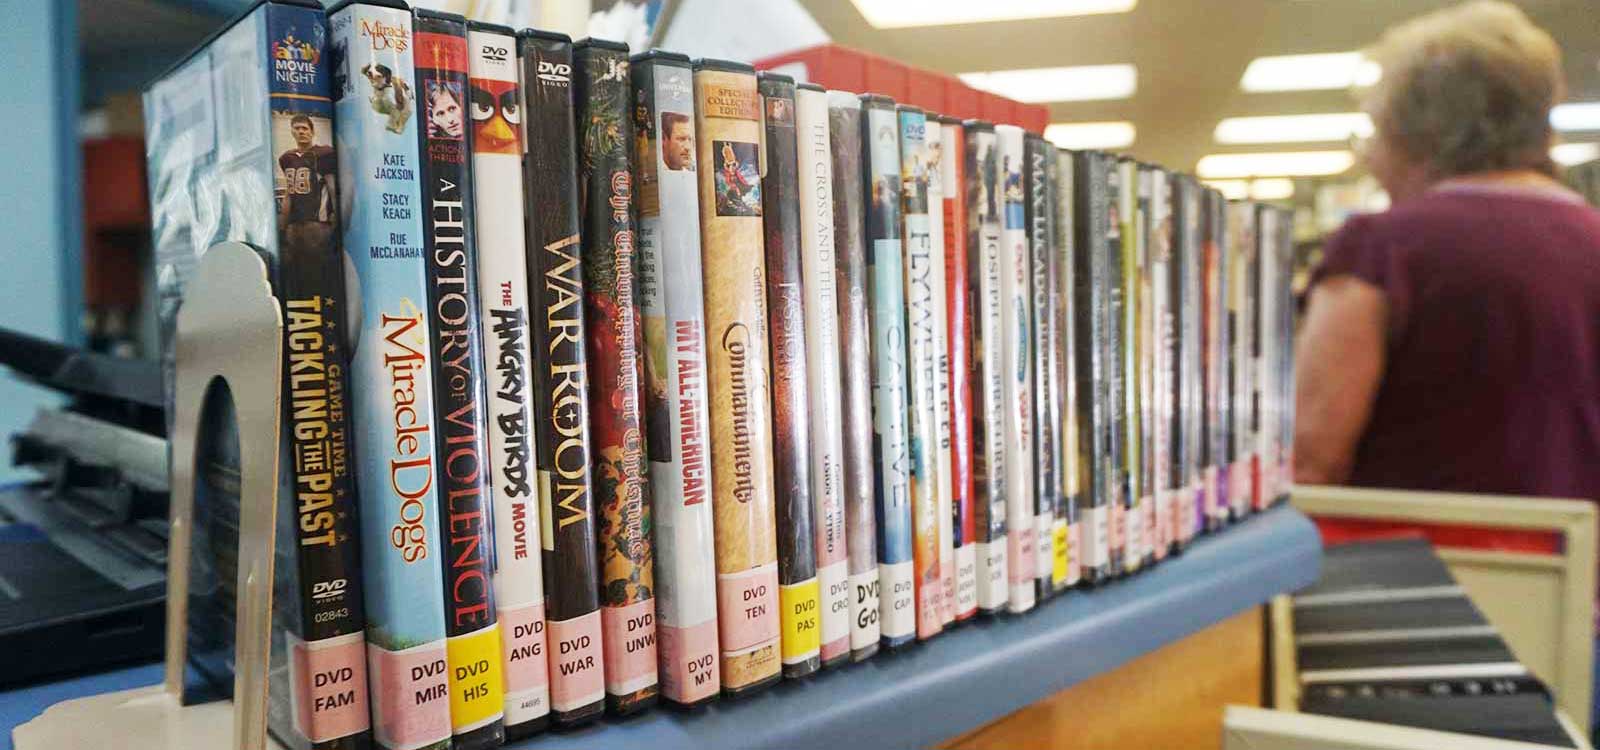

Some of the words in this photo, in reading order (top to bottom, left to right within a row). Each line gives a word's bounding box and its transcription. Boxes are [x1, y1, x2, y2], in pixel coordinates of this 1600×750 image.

[361, 19, 410, 40] Miracle
[272, 41, 320, 64] family
[372, 33, 409, 53] Dogs
[482, 46, 508, 56] DVD
[276, 59, 316, 73] MOVIE
[276, 70, 317, 84] NIGHT
[538, 61, 571, 75] DVD
[542, 80, 568, 88] VIDEO
[814, 122, 825, 154] THE
[383, 153, 406, 166] KATE
[374, 168, 414, 181] JACKSON
[439, 178, 457, 192] A
[1032, 153, 1045, 205] MAX
[382, 193, 409, 207] STACY
[608, 170, 632, 224] The
[816, 161, 828, 217] CROSS
[383, 207, 411, 220] KEACH
[390, 232, 407, 246] RUE
[818, 222, 830, 262] AND
[1033, 215, 1046, 308] LUCADO
[432, 199, 471, 375] HISTORY
[820, 270, 831, 303] THE
[986, 235, 1000, 318] JOSEPH
[500, 281, 512, 307] THE
[543, 233, 583, 355] WAR
[614, 229, 637, 390] Unwrapping
[675, 320, 700, 352] MY
[490, 306, 527, 404] ANGRY
[286, 296, 328, 440] TACKLING
[677, 359, 700, 395] ALL
[327, 363, 344, 423] GAME
[382, 313, 430, 456] Miracle
[451, 375, 466, 401] OF
[722, 322, 754, 504] Commandments
[303, 442, 321, 472] THE
[331, 429, 346, 477] TIME
[498, 409, 531, 498] BIRDS
[551, 362, 589, 532] ROOM
[679, 399, 705, 507] AMERICAN
[622, 427, 645, 562] Christmas
[297, 472, 337, 548] PAST
[391, 456, 432, 563] Dogs
[445, 400, 488, 626] VIOLENCE
[511, 503, 527, 560] MOVIE
[826, 512, 834, 554] VIDEO
[312, 579, 347, 593] DVD
[743, 585, 766, 601] DVD
[830, 580, 848, 596] DVD
[857, 580, 880, 604] DVD
[894, 581, 912, 594] DVD
[315, 608, 348, 623] 02843
[745, 606, 766, 620] TEN
[795, 600, 816, 615] DVD
[895, 597, 912, 612] CAP
[514, 620, 544, 639] DVD
[627, 614, 653, 632] DVD
[797, 619, 815, 632] PAS
[510, 643, 541, 663] ANG
[559, 636, 590, 655] DVD
[411, 660, 447, 682] DVD
[455, 660, 489, 681] DVD
[559, 656, 595, 676] WAR
[688, 654, 713, 673] DVD
[314, 667, 353, 688] DVD
[695, 669, 712, 686] MY
[315, 690, 355, 712] FAM
[415, 683, 448, 705] MIR
[463, 683, 489, 702] HIS
